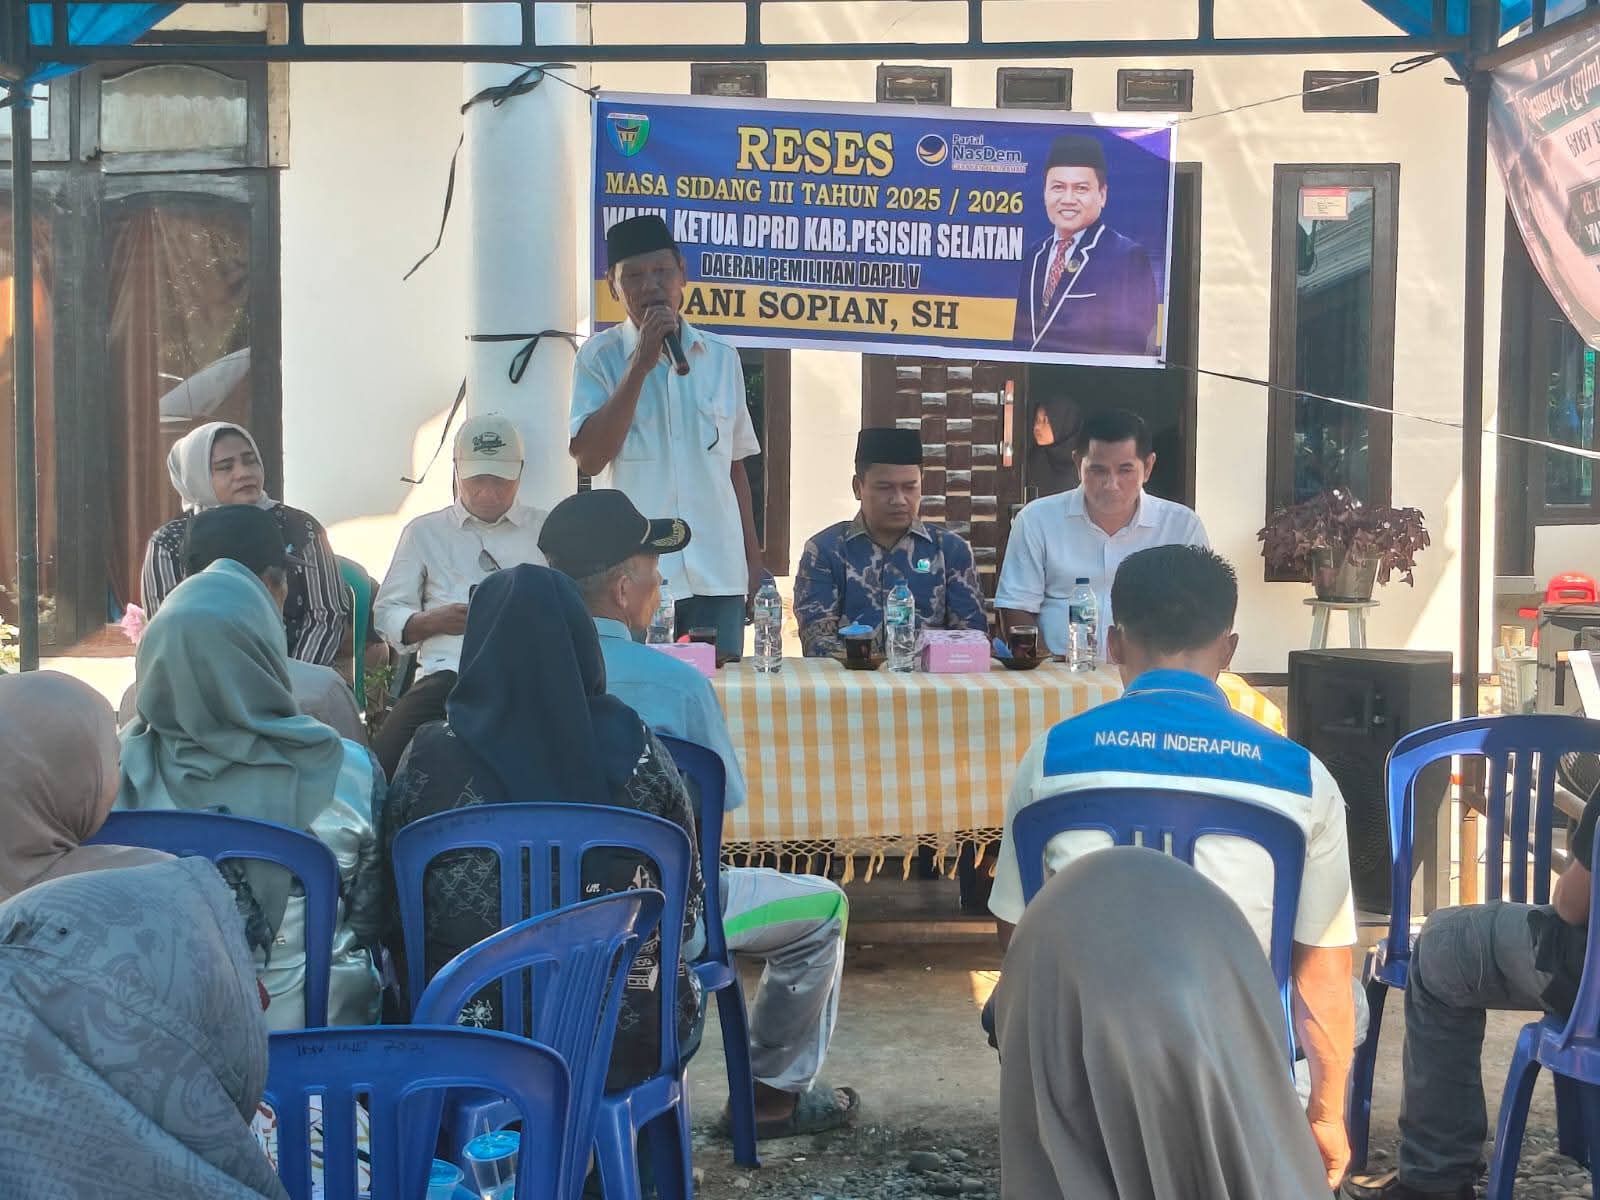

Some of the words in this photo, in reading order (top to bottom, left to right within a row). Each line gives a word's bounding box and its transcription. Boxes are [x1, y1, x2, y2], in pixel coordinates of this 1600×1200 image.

[736, 126, 894, 177] RESES
[953, 134, 984, 145] Partai
[953, 145, 1022, 162] NasDem
[605, 172, 669, 196] MASA
[676, 176, 762, 203] SIDANG
[769, 181, 794, 204] III
[801, 183, 879, 208] TAHUN
[886, 186, 941, 211] 2025
[948, 189, 961, 215] /
[967, 189, 1024, 213] 2026
[673, 210, 739, 247] KETUA
[742, 213, 798, 250] DPRD
[803, 217, 932, 256] KAB.PESISIR
[936, 224, 1023, 261] SELATAN
[701, 251, 766, 279] DAERAH
[768, 255, 856, 285] PEMILIHAN
[858, 258, 906, 288] DAPIL
[907, 262, 922, 289] V
[759, 291, 898, 331] SOPIAN,
[911, 299, 960, 330] SH
[1094, 731, 1156, 748] NAGARI
[1163, 733, 1263, 760] INDERAPURA
